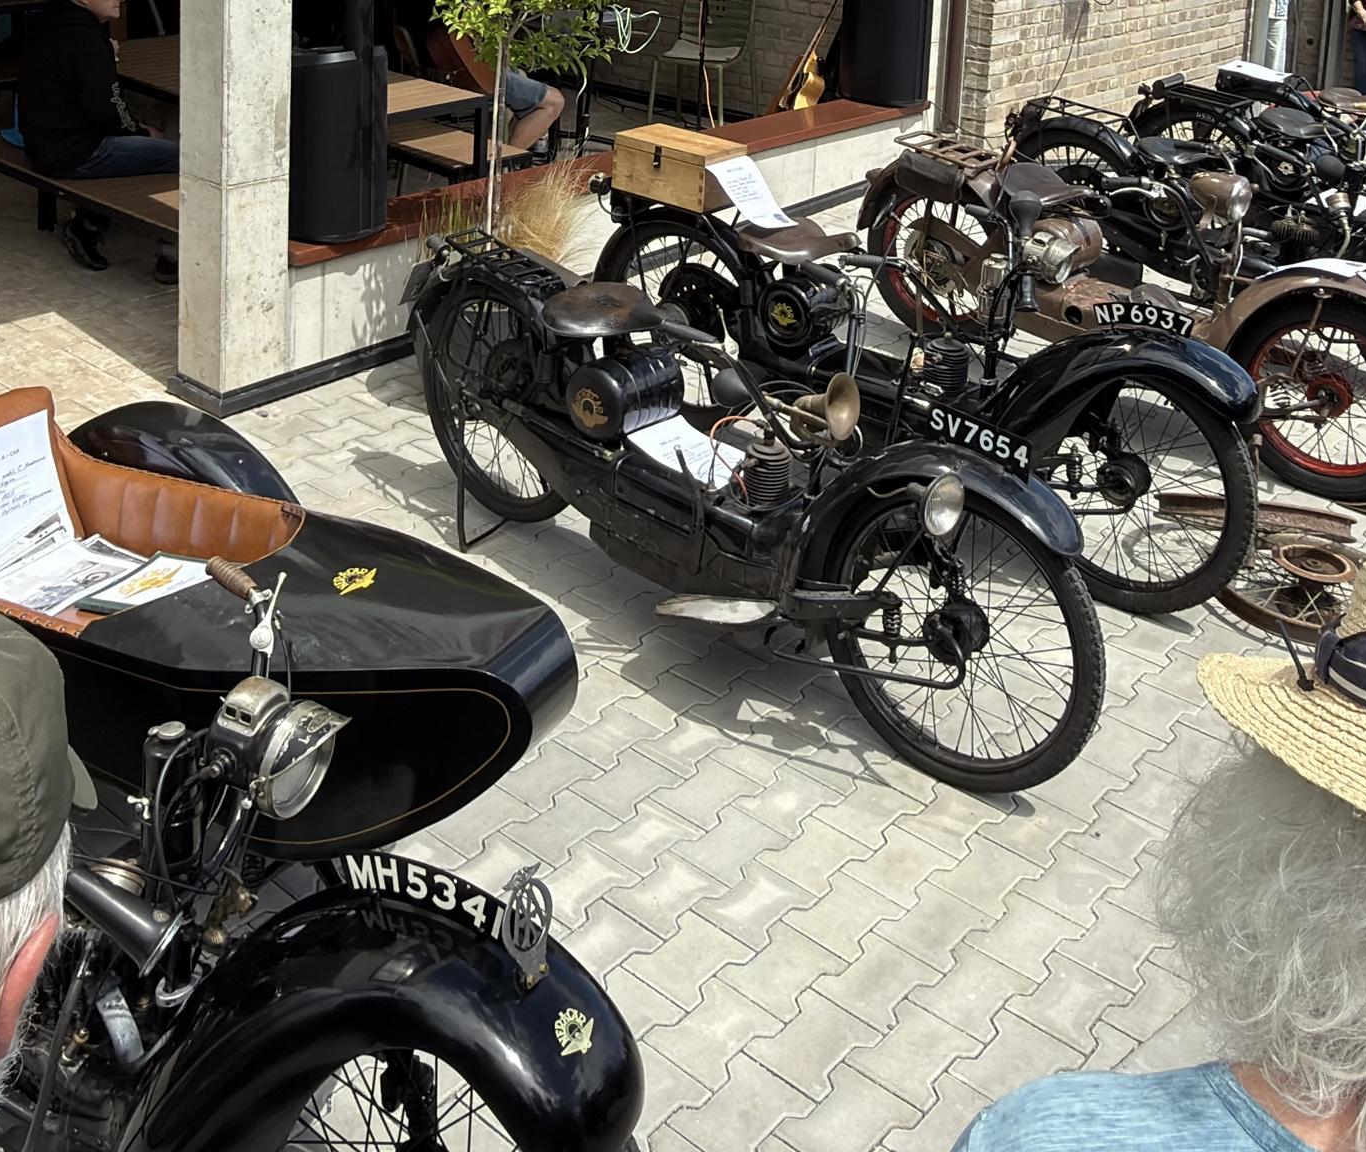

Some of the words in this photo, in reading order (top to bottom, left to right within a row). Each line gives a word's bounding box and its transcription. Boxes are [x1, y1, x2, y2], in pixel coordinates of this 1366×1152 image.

[1094, 303, 1125, 323] NP
[1130, 305, 1192, 335] 6937
[929, 408, 1029, 468] SV7654
[345, 854, 504, 940] MH5341
